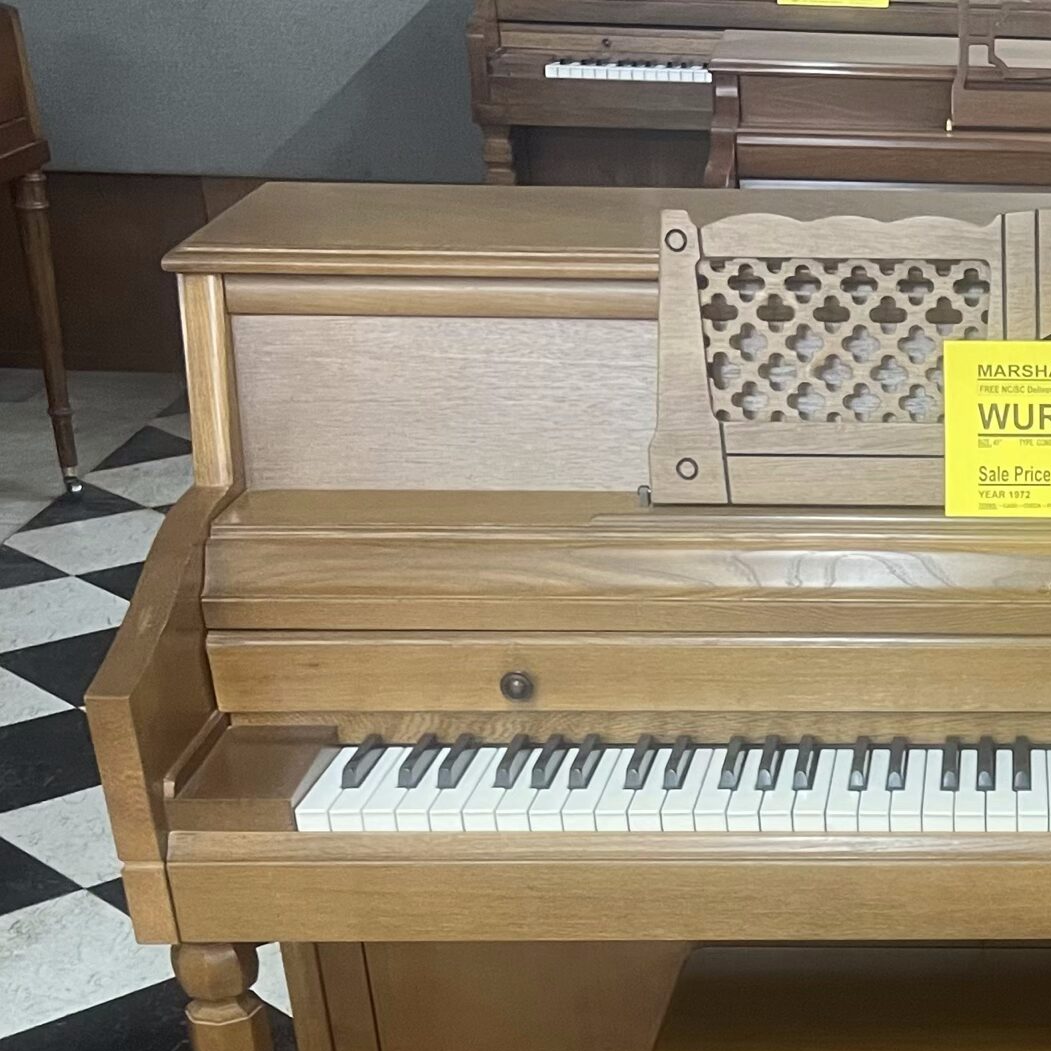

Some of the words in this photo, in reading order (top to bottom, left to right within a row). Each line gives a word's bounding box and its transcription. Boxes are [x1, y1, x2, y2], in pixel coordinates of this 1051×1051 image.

[980, 385, 999, 393] FREE
[1001, 385, 1025, 393] NC/SC
[979, 466, 1010, 482] Sale
[1014, 466, 1051, 482] Price
[979, 490, 1006, 499] YEAR
[1009, 491, 1031, 499] 1972
